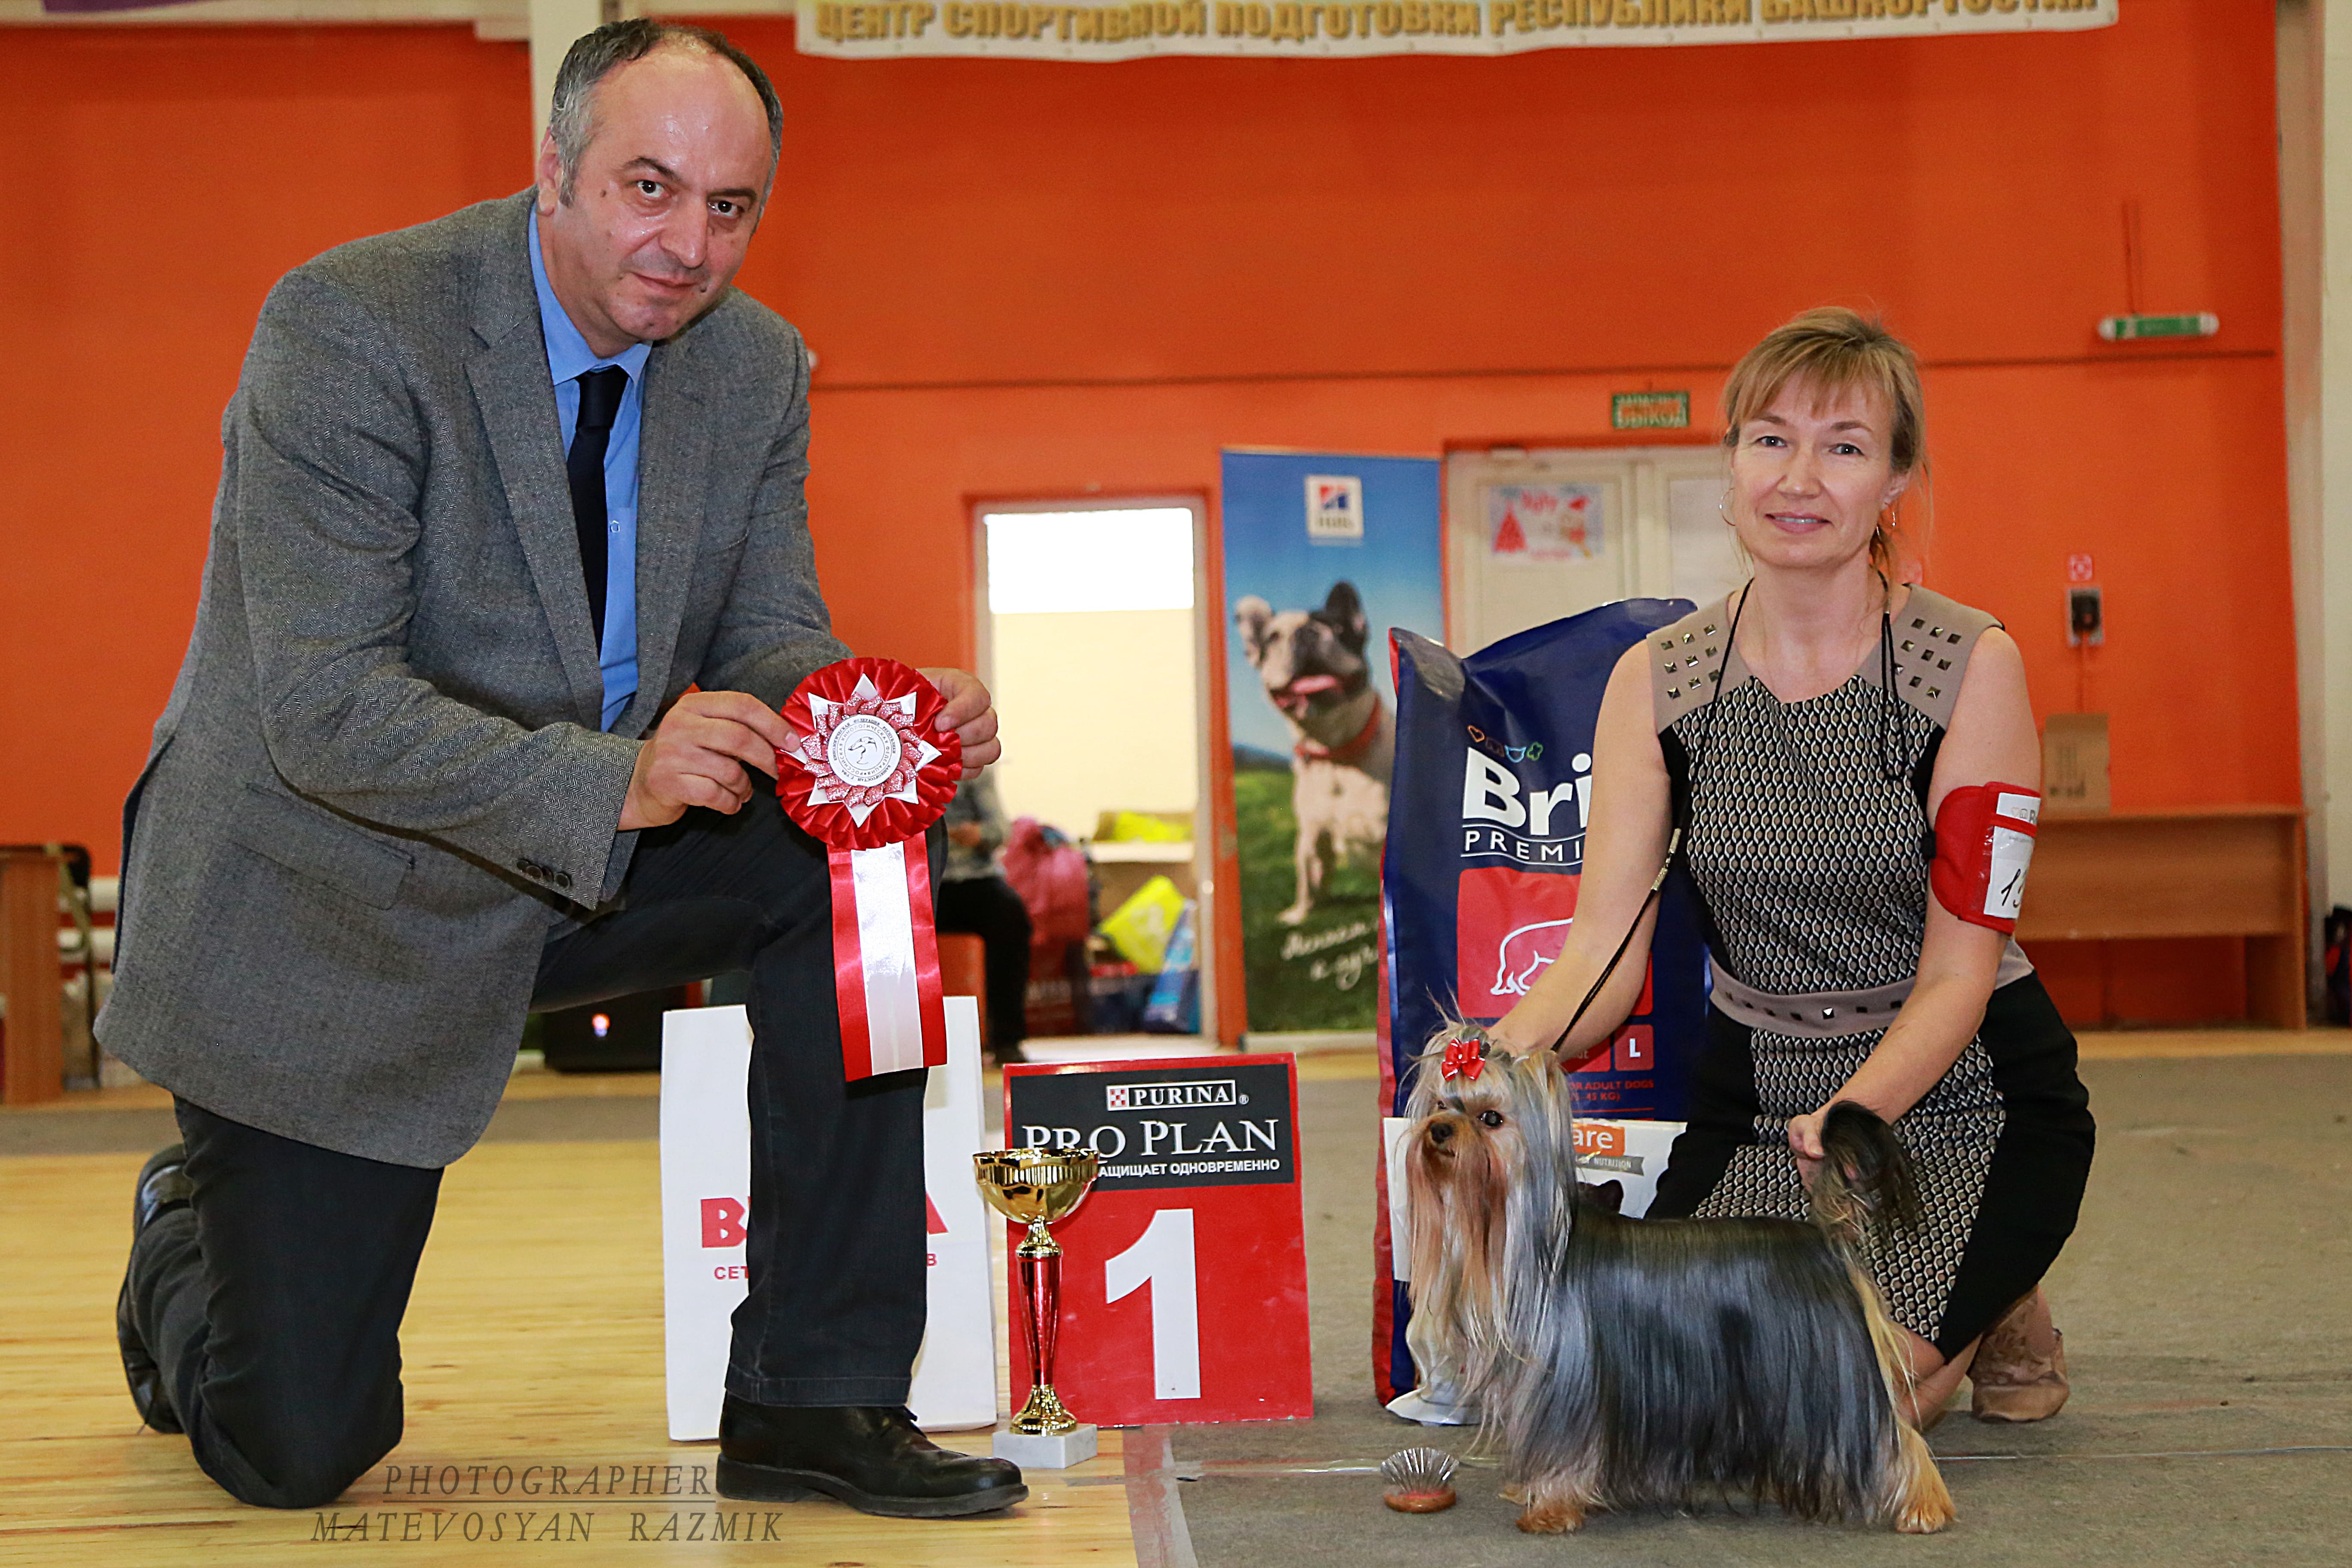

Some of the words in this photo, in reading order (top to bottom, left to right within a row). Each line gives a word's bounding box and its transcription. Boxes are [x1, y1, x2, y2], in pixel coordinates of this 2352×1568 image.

[815, 2, 936, 42] ЦЕНТР
[943, 0, 1207, 43] СПОРТИВНОЙ
[1215, 1, 1480, 43] ПОДГОТОВКИ
[1490, 0, 1752, 35] РЕСПУБЛИКИ
[1463, 747, 1592, 836] Bri
[1465, 831, 1581, 862] PREMI
[1629, 1038, 1641, 1058] L
[1569, 1082, 1583, 1090] OR
[1585, 1081, 1621, 1090] ADULT
[1625, 1079, 1654, 1089] DOGS
[1135, 1085, 1230, 1107] PURINA
[1022, 1125, 1127, 1165] PRO
[1139, 1119, 1279, 1157] PLAN
[1573, 1128, 1614, 1149] are
[1098, 1162, 1168, 1179] АЩИЩАЕТ
[1170, 1158, 1281, 1176] ОДНОВРЕМЕННО
[1594, 1157, 1632, 1168] NUTRITION
[714, 1265, 749, 1280] СЕТ
[1105, 1208, 1201, 1400] 1
